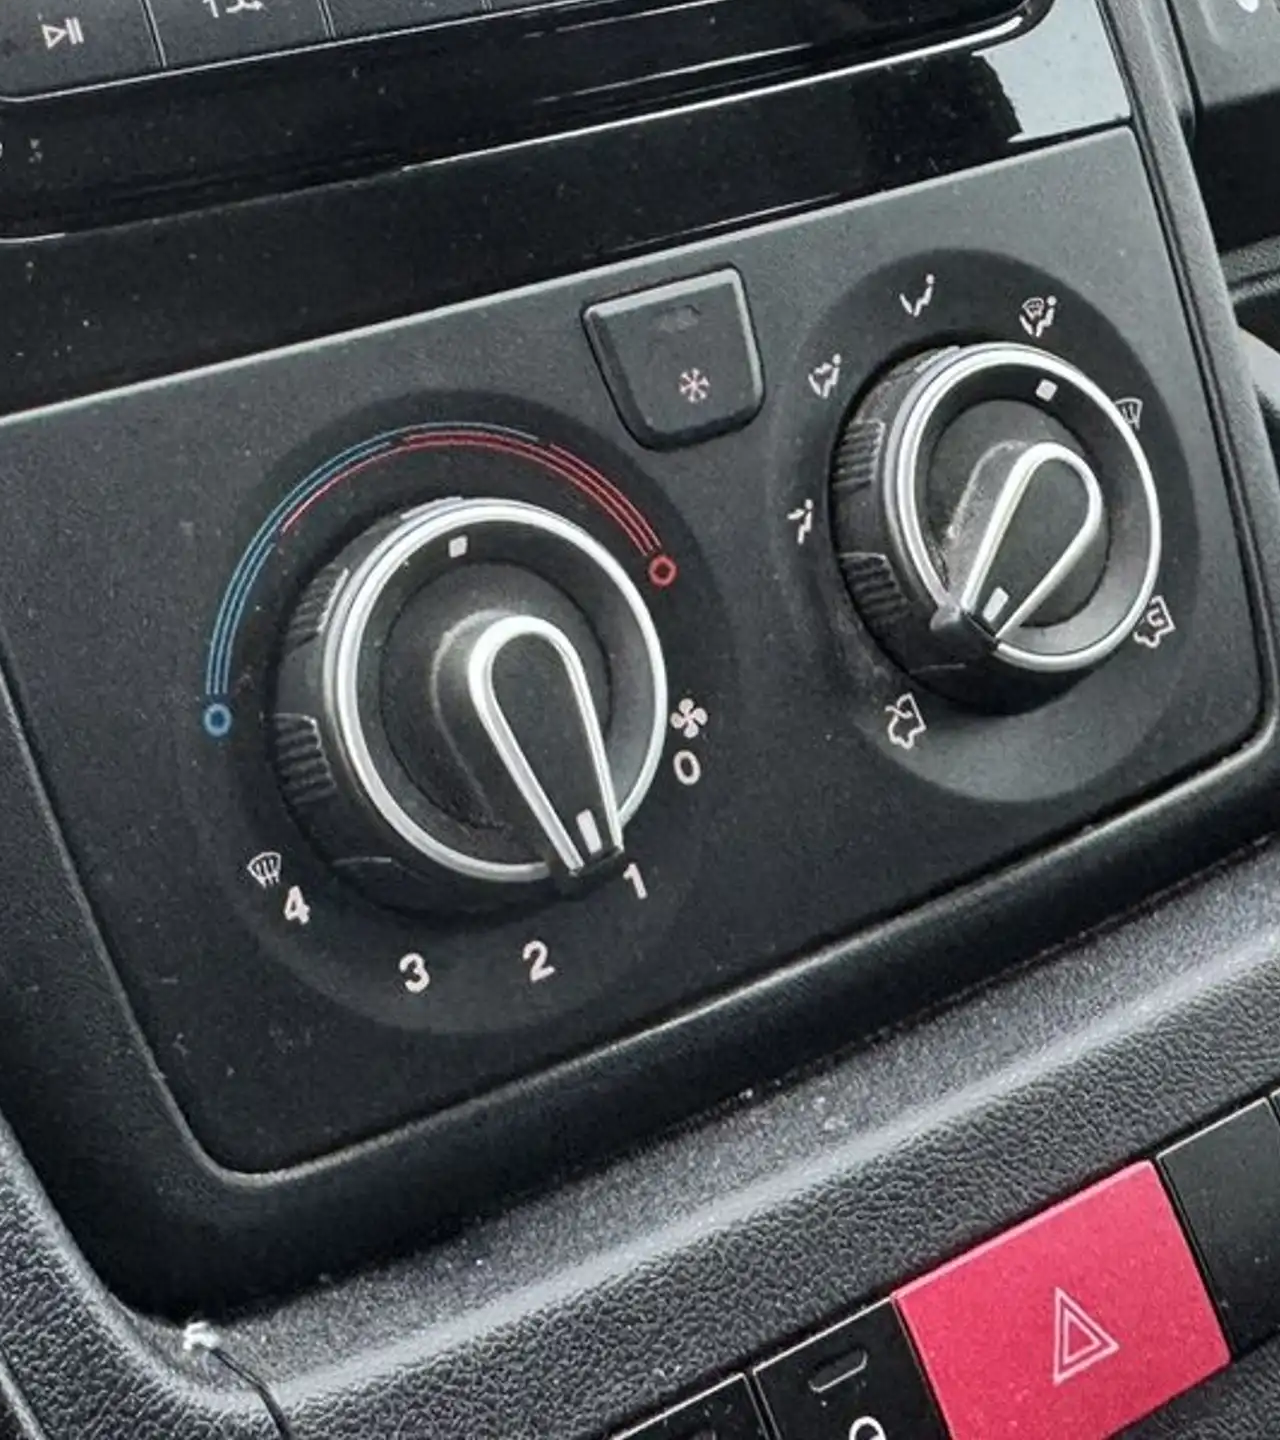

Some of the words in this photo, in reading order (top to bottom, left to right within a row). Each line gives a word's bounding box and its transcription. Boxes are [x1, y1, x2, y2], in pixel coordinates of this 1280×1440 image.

[673, 749, 701, 786] 0
[622, 862, 649, 900] 1
[283, 885, 311, 926] 4
[398, 952, 431, 994] 3
[522, 939, 557, 983] 2
